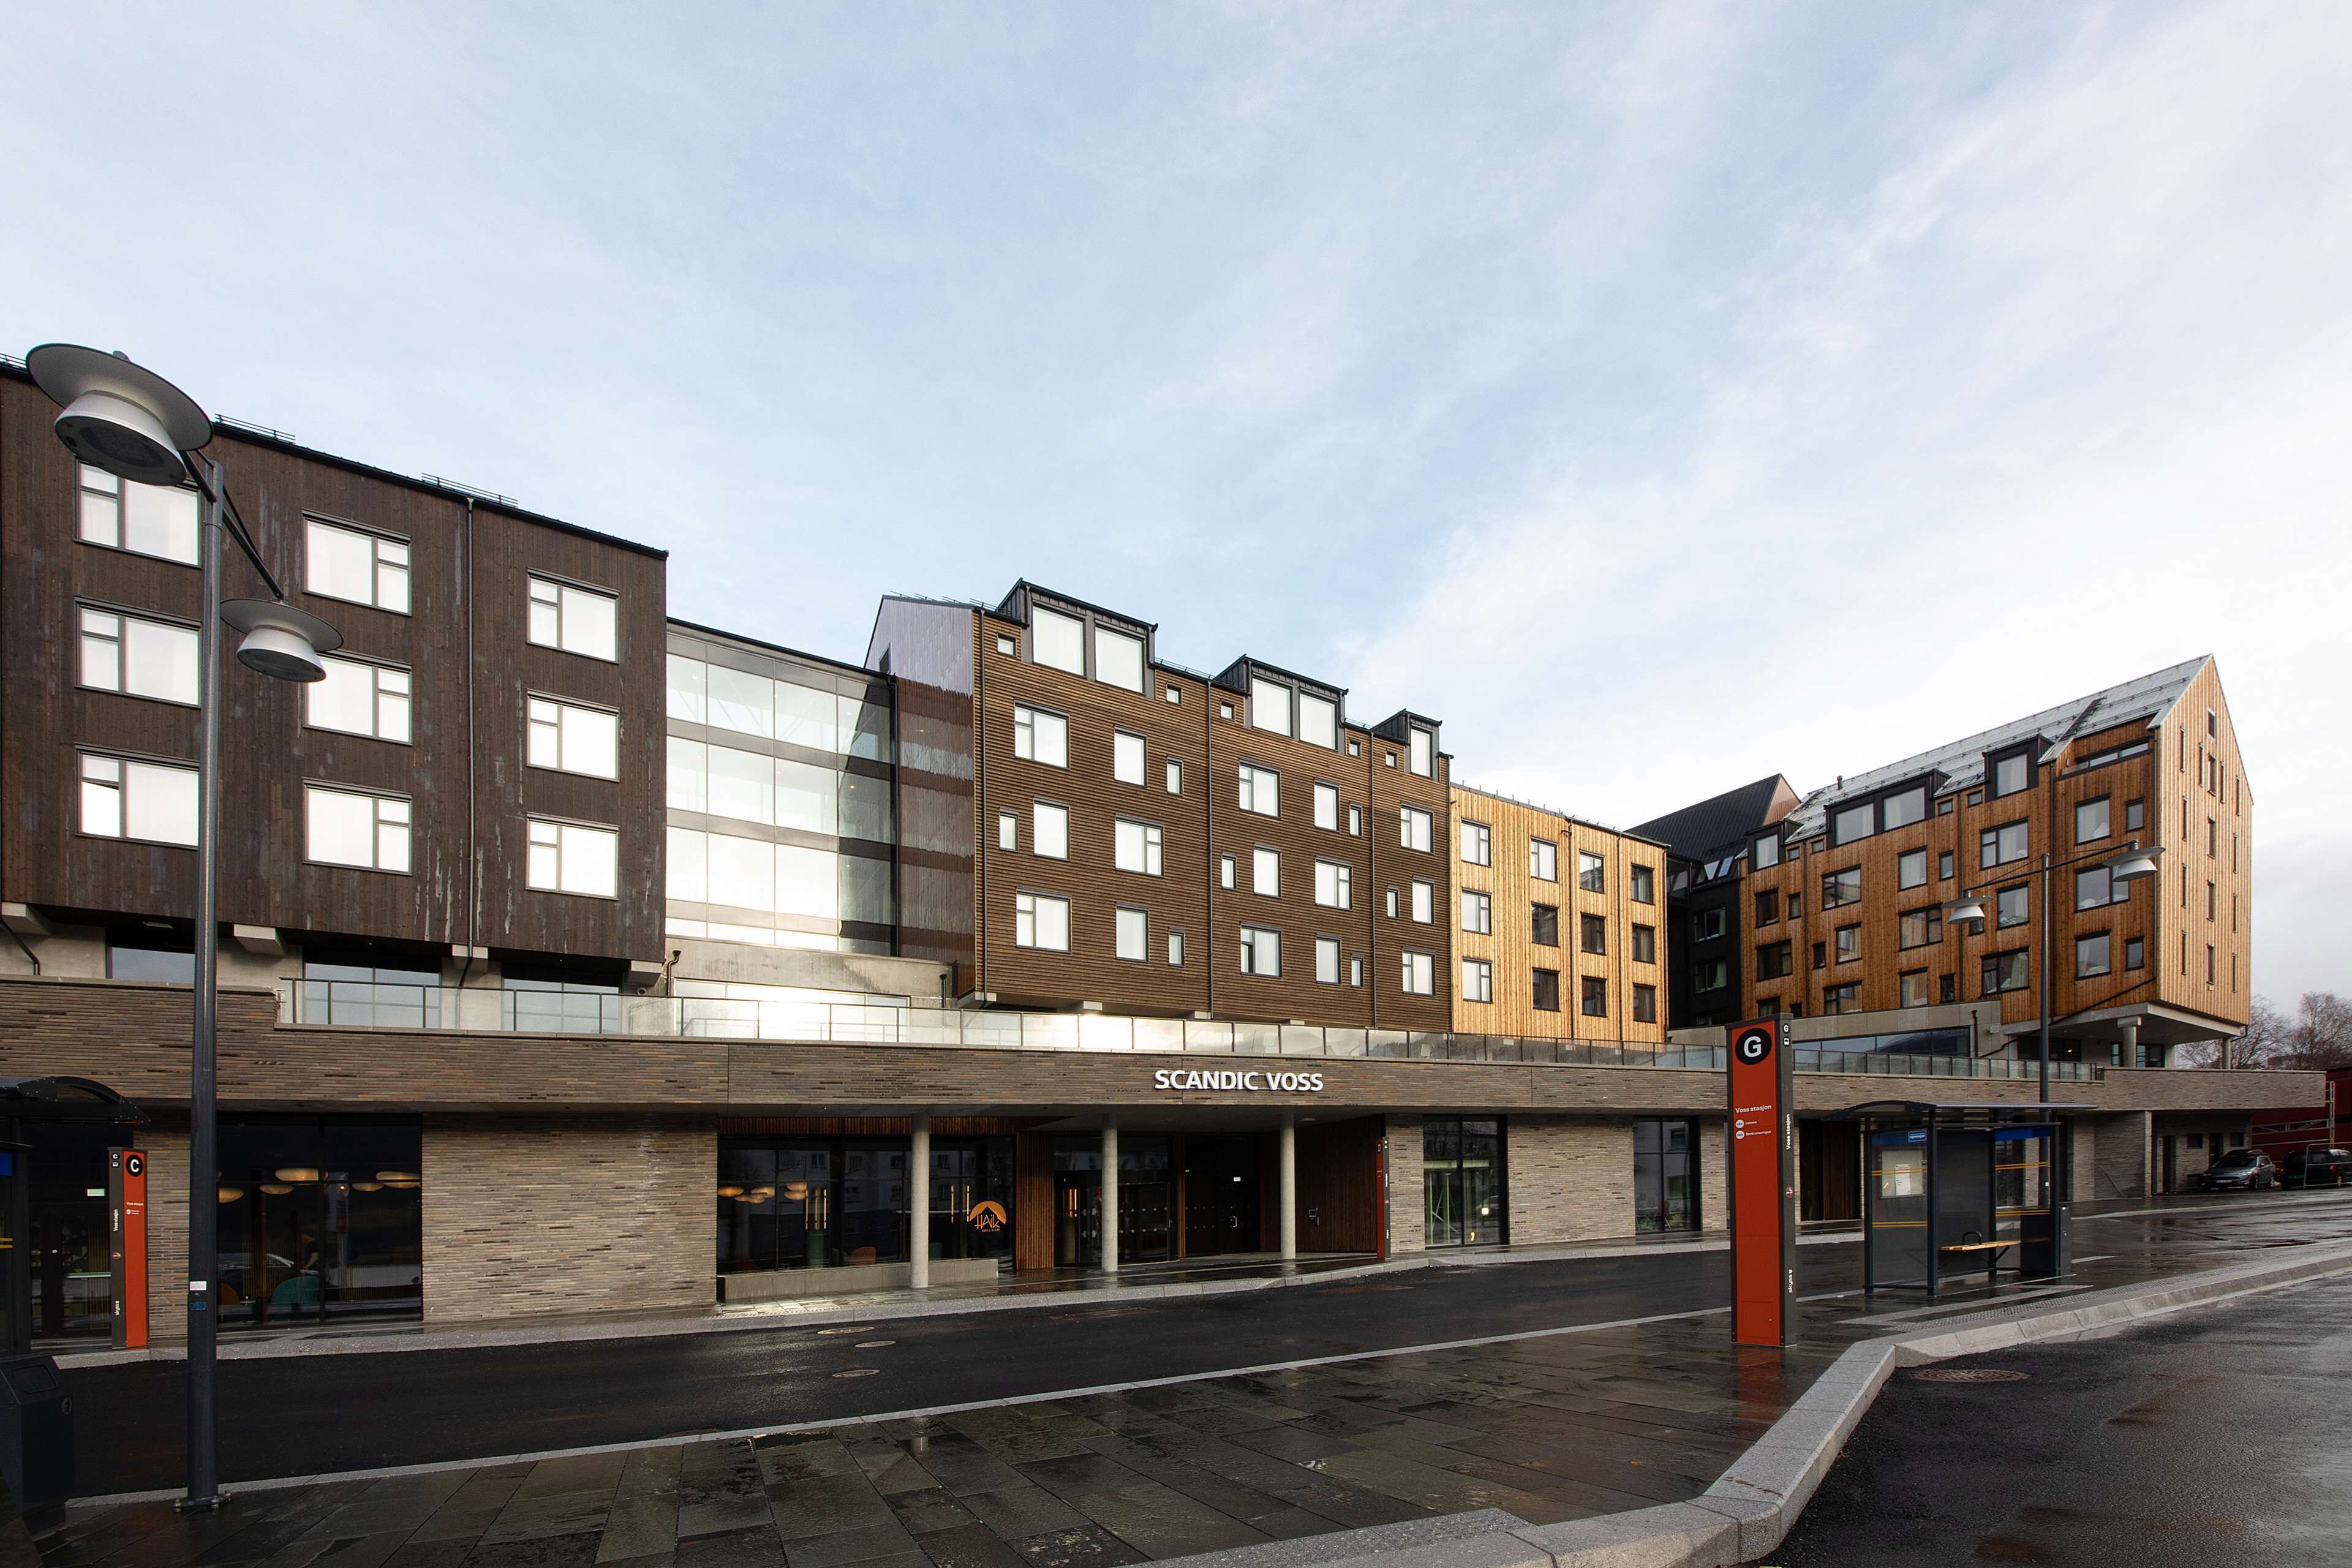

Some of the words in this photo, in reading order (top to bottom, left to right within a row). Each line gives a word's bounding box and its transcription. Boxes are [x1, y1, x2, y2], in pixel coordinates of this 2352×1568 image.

[1744, 1036, 1762, 1058] G
[1155, 1070, 1259, 1090] SCANDIC
[1265, 1072, 1324, 1091] VOSS
[130, 1159, 140, 1172] C
